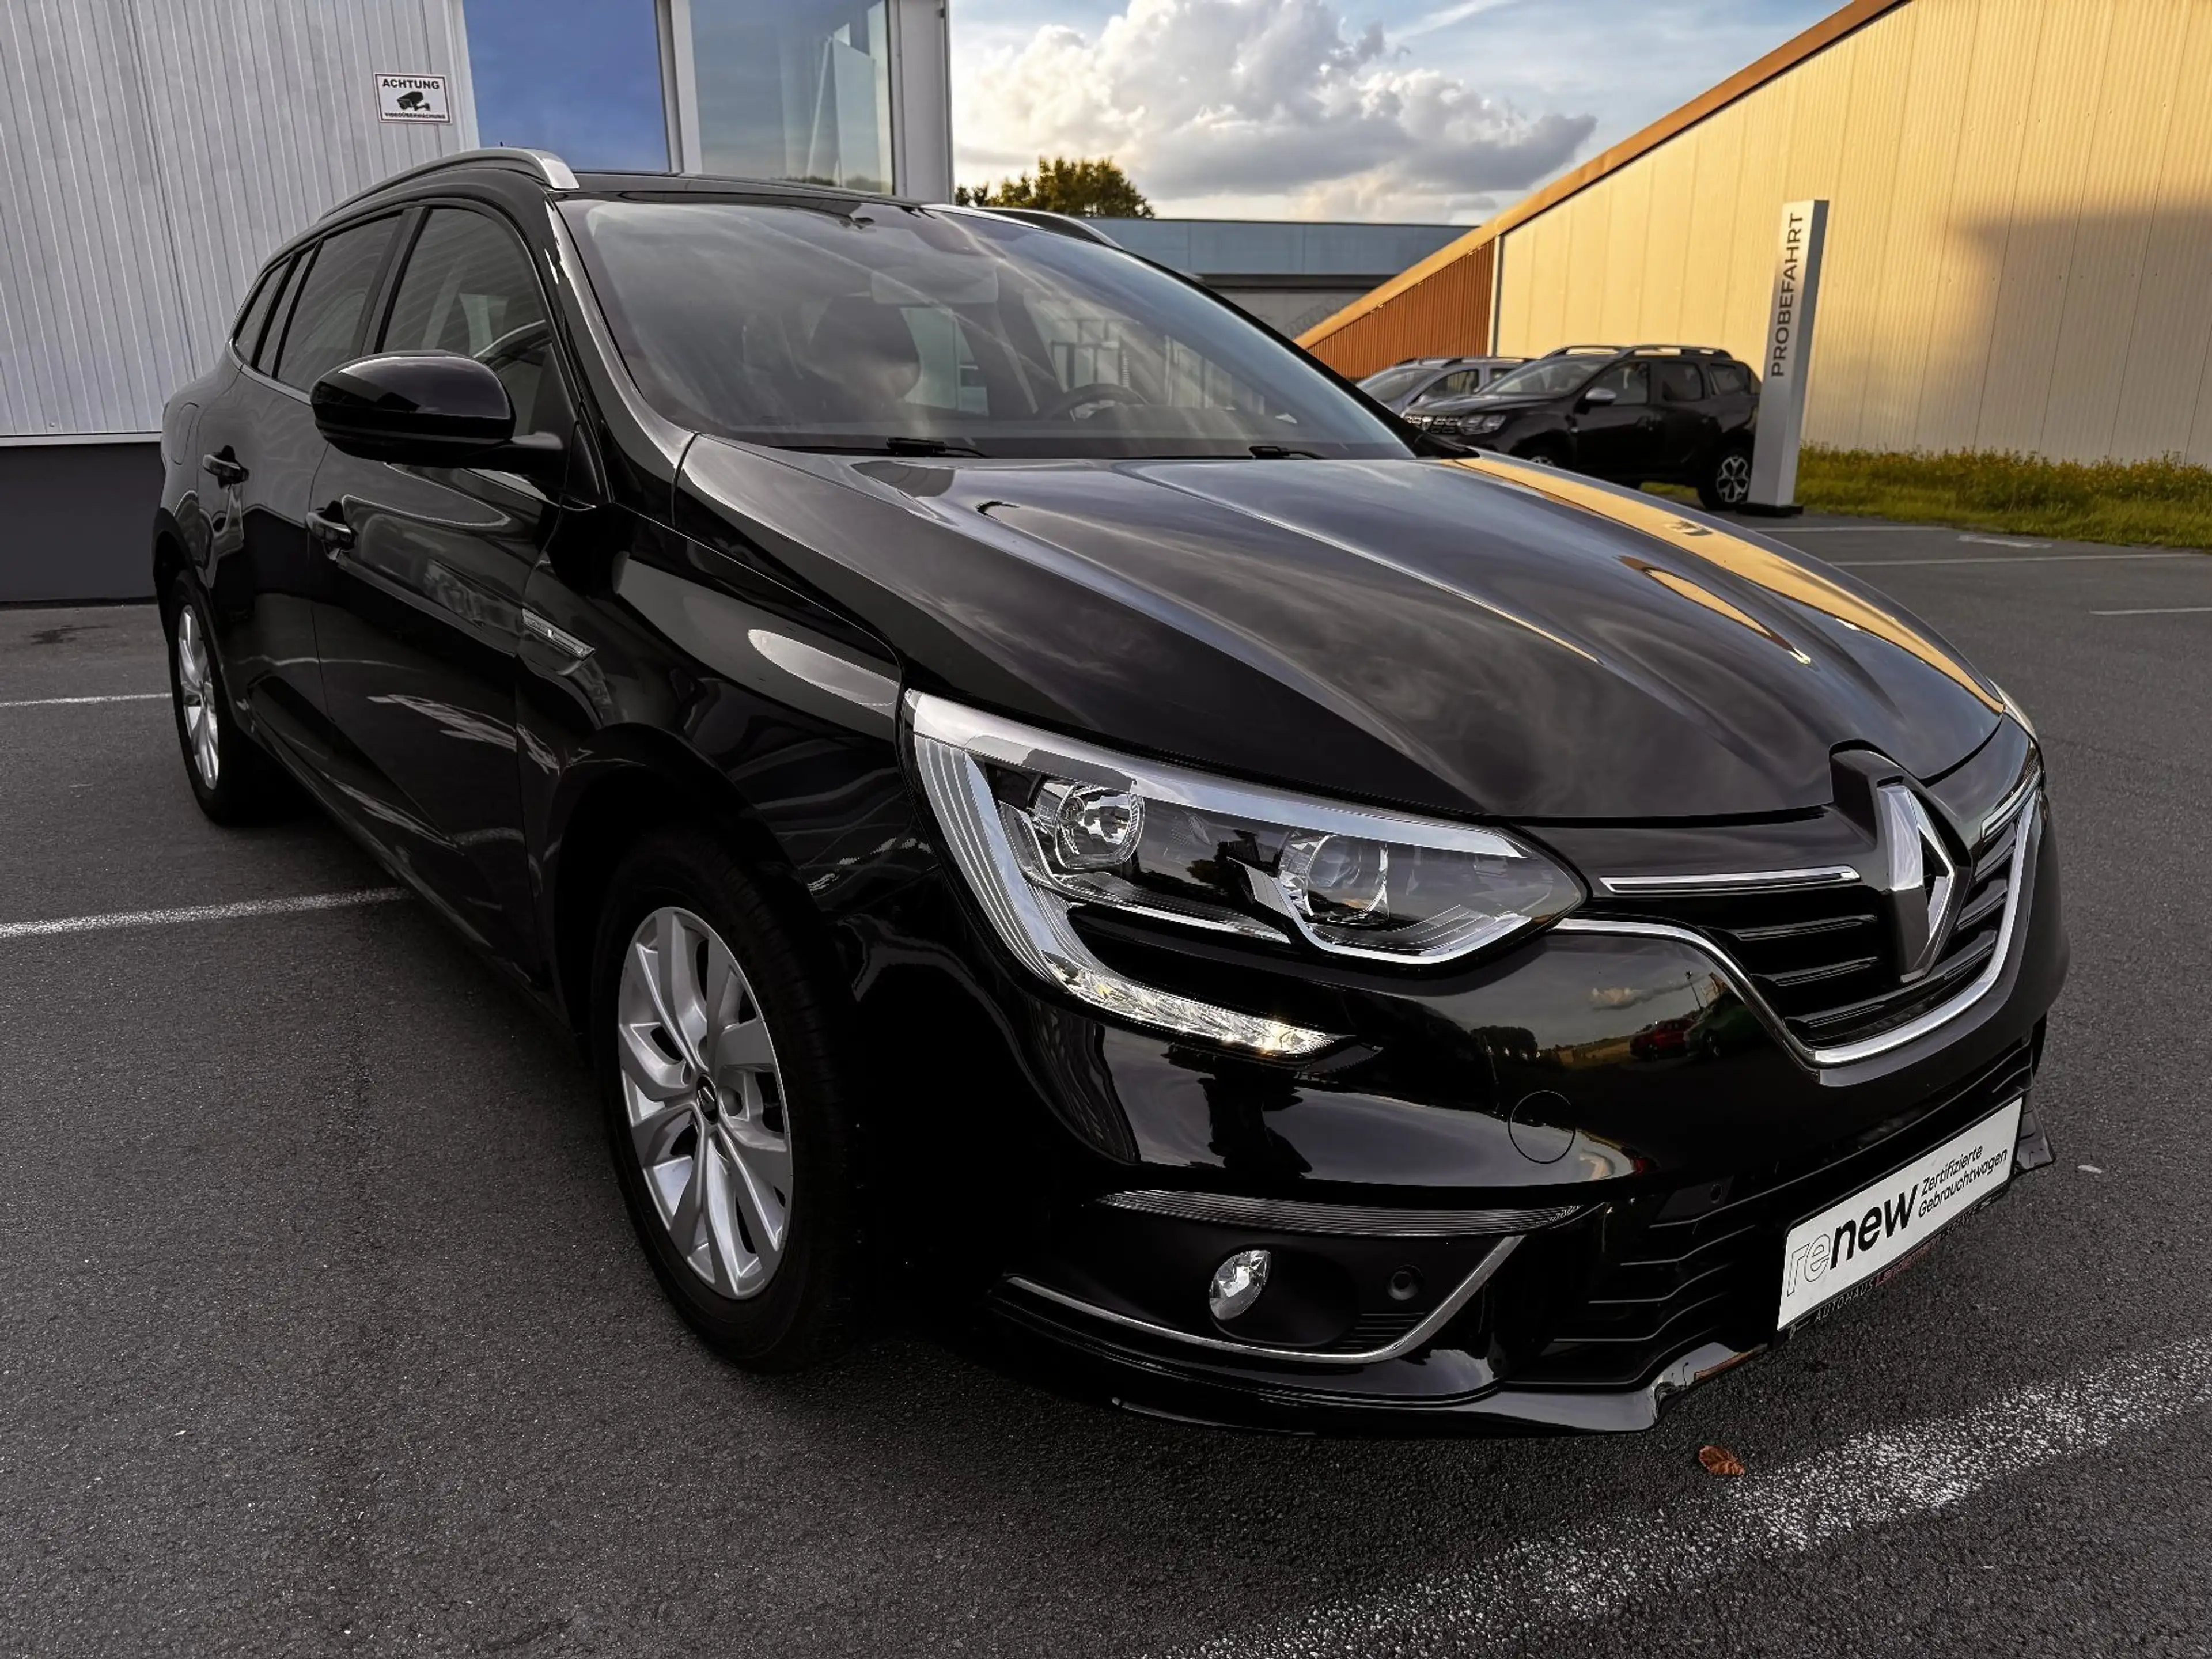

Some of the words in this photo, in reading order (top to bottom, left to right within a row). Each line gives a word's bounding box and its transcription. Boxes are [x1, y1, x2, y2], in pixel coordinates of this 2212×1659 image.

[382, 78, 440, 89] ACHTUNG
[1771, 212, 1803, 377] PROBEFAHRT
[1918, 1149, 2008, 1218] Gebrauchtwagen
[1921, 1145, 1983, 1197] Zertifizierte
[1787, 1183, 1919, 1297] renew
